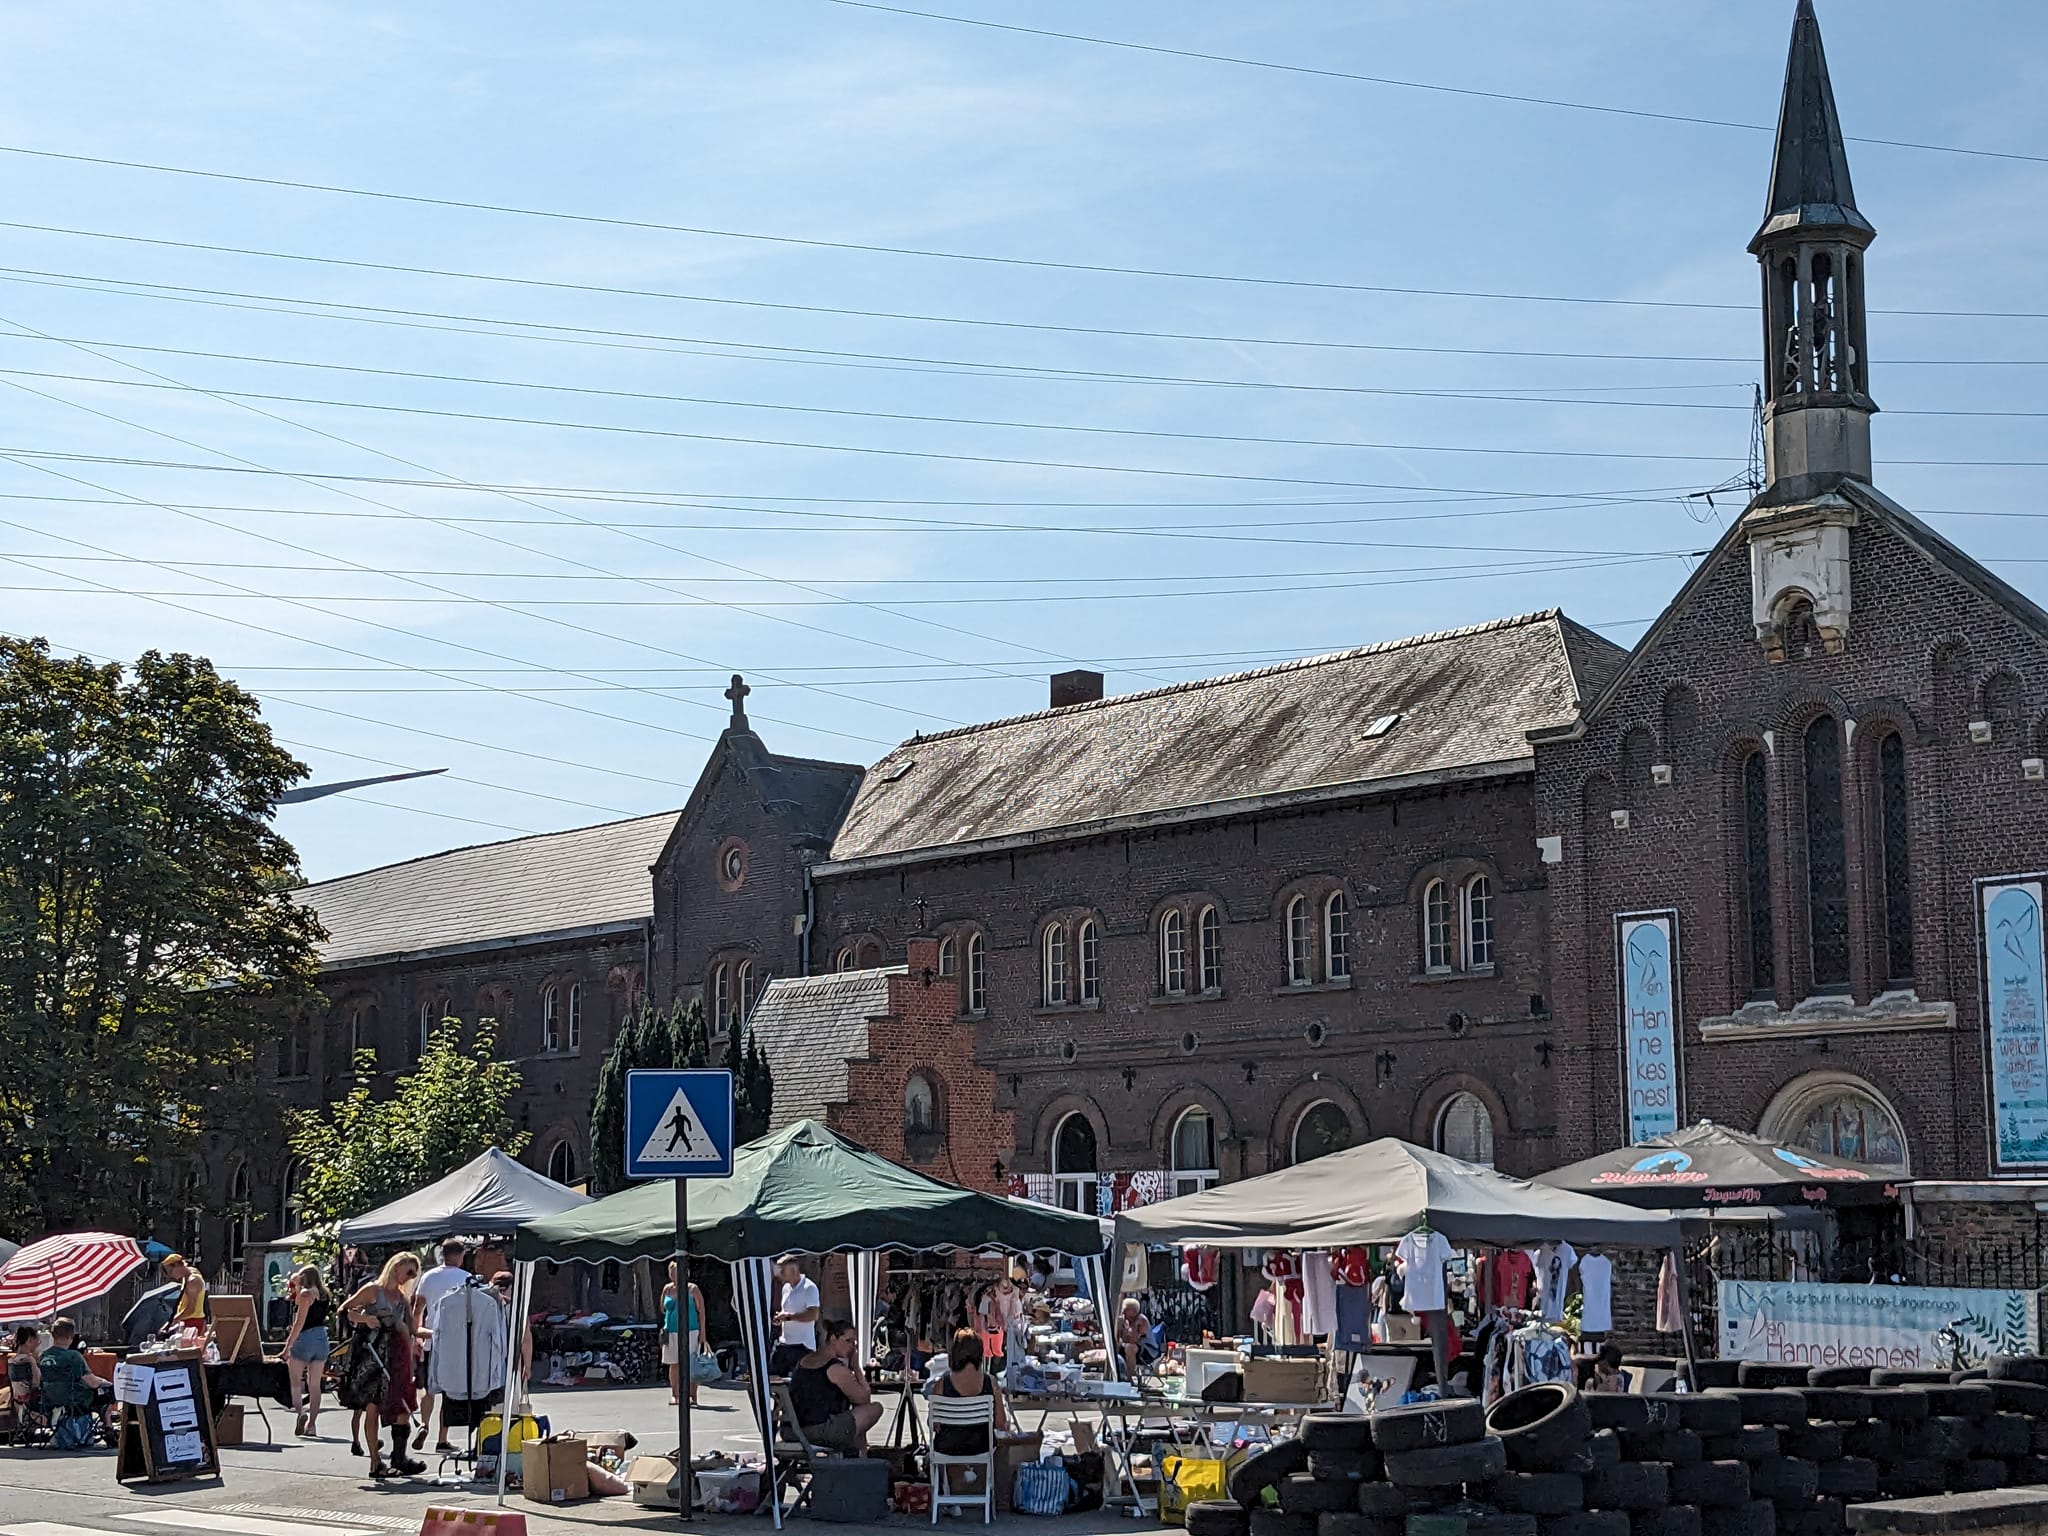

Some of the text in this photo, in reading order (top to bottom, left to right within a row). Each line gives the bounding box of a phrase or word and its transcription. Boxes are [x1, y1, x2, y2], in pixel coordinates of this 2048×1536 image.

[1631, 1006, 1668, 1030] Han
[1639, 1037, 1662, 1055] ne
[1635, 1058, 1667, 1081] kes
[1633, 1083, 1671, 1107] nest
[1766, 1335, 1921, 1369] Hannekesnest
